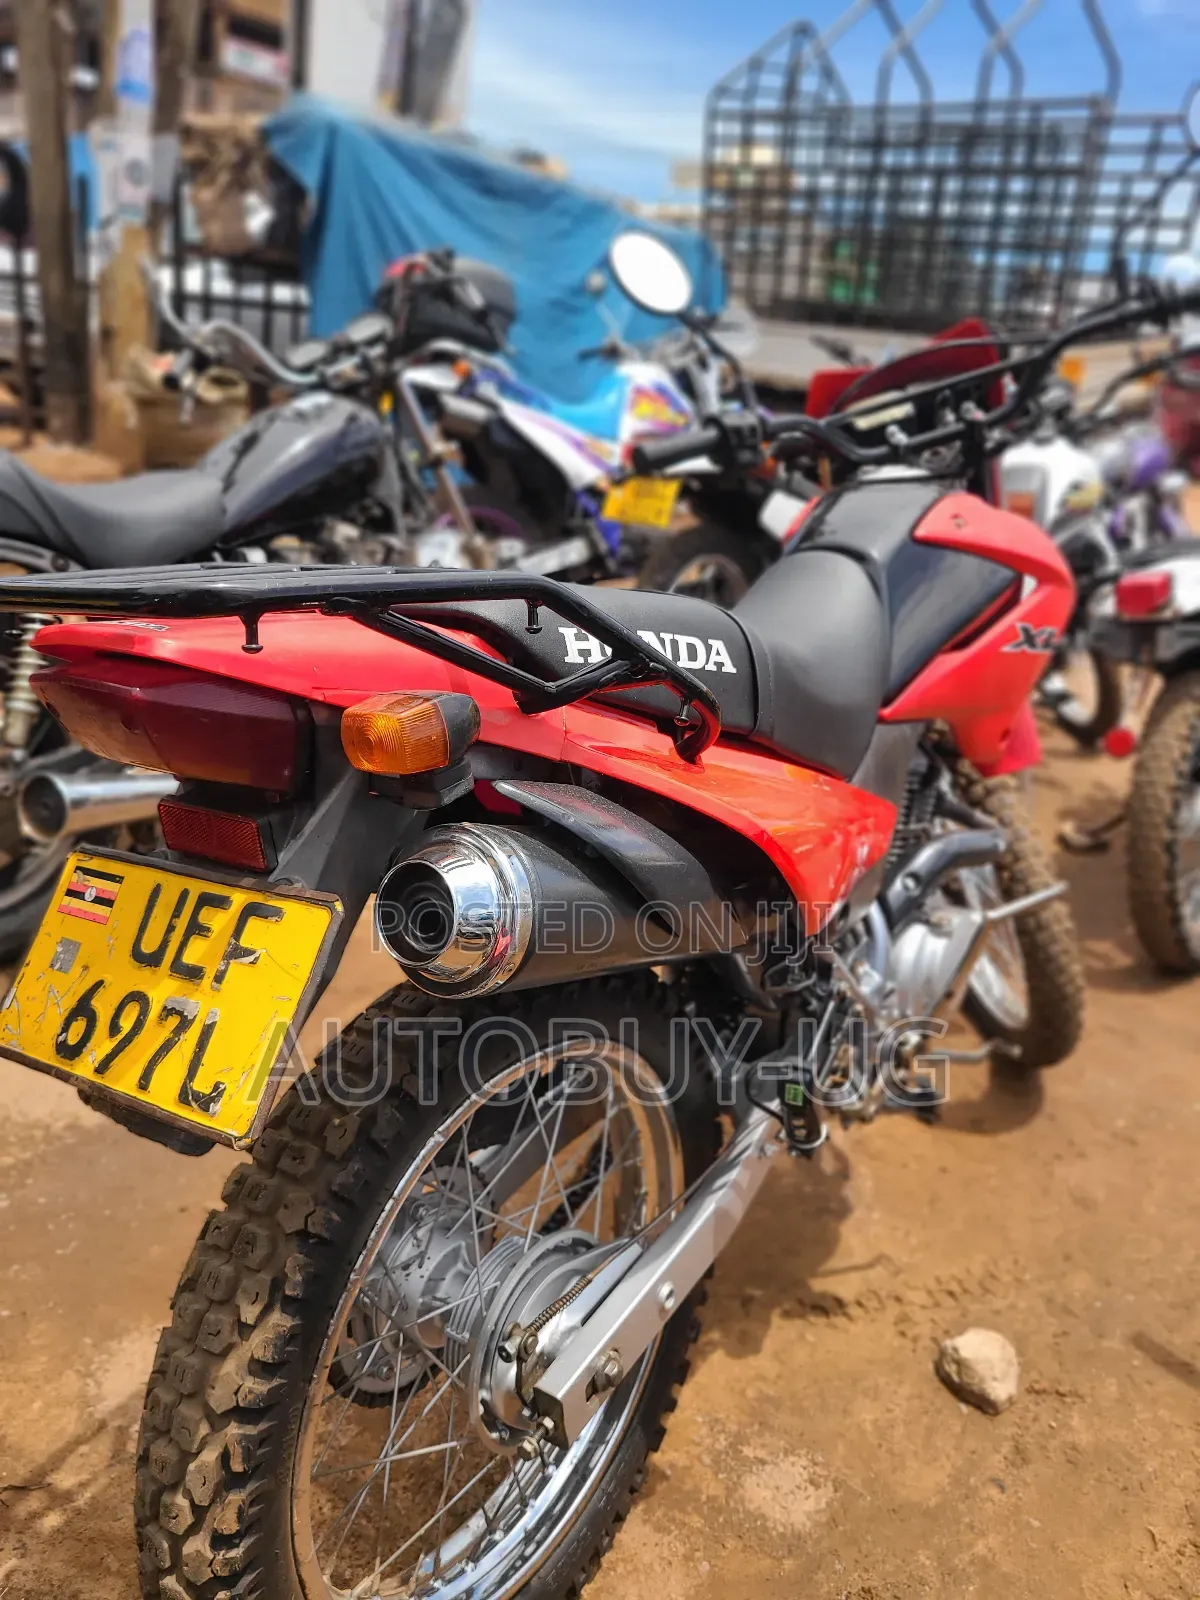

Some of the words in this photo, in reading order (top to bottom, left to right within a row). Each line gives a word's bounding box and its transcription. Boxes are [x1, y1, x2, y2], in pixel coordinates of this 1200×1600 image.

[558, 627, 737, 673] HNDA
[131, 882, 286, 991] UEF
[55, 979, 227, 1117] 697L
